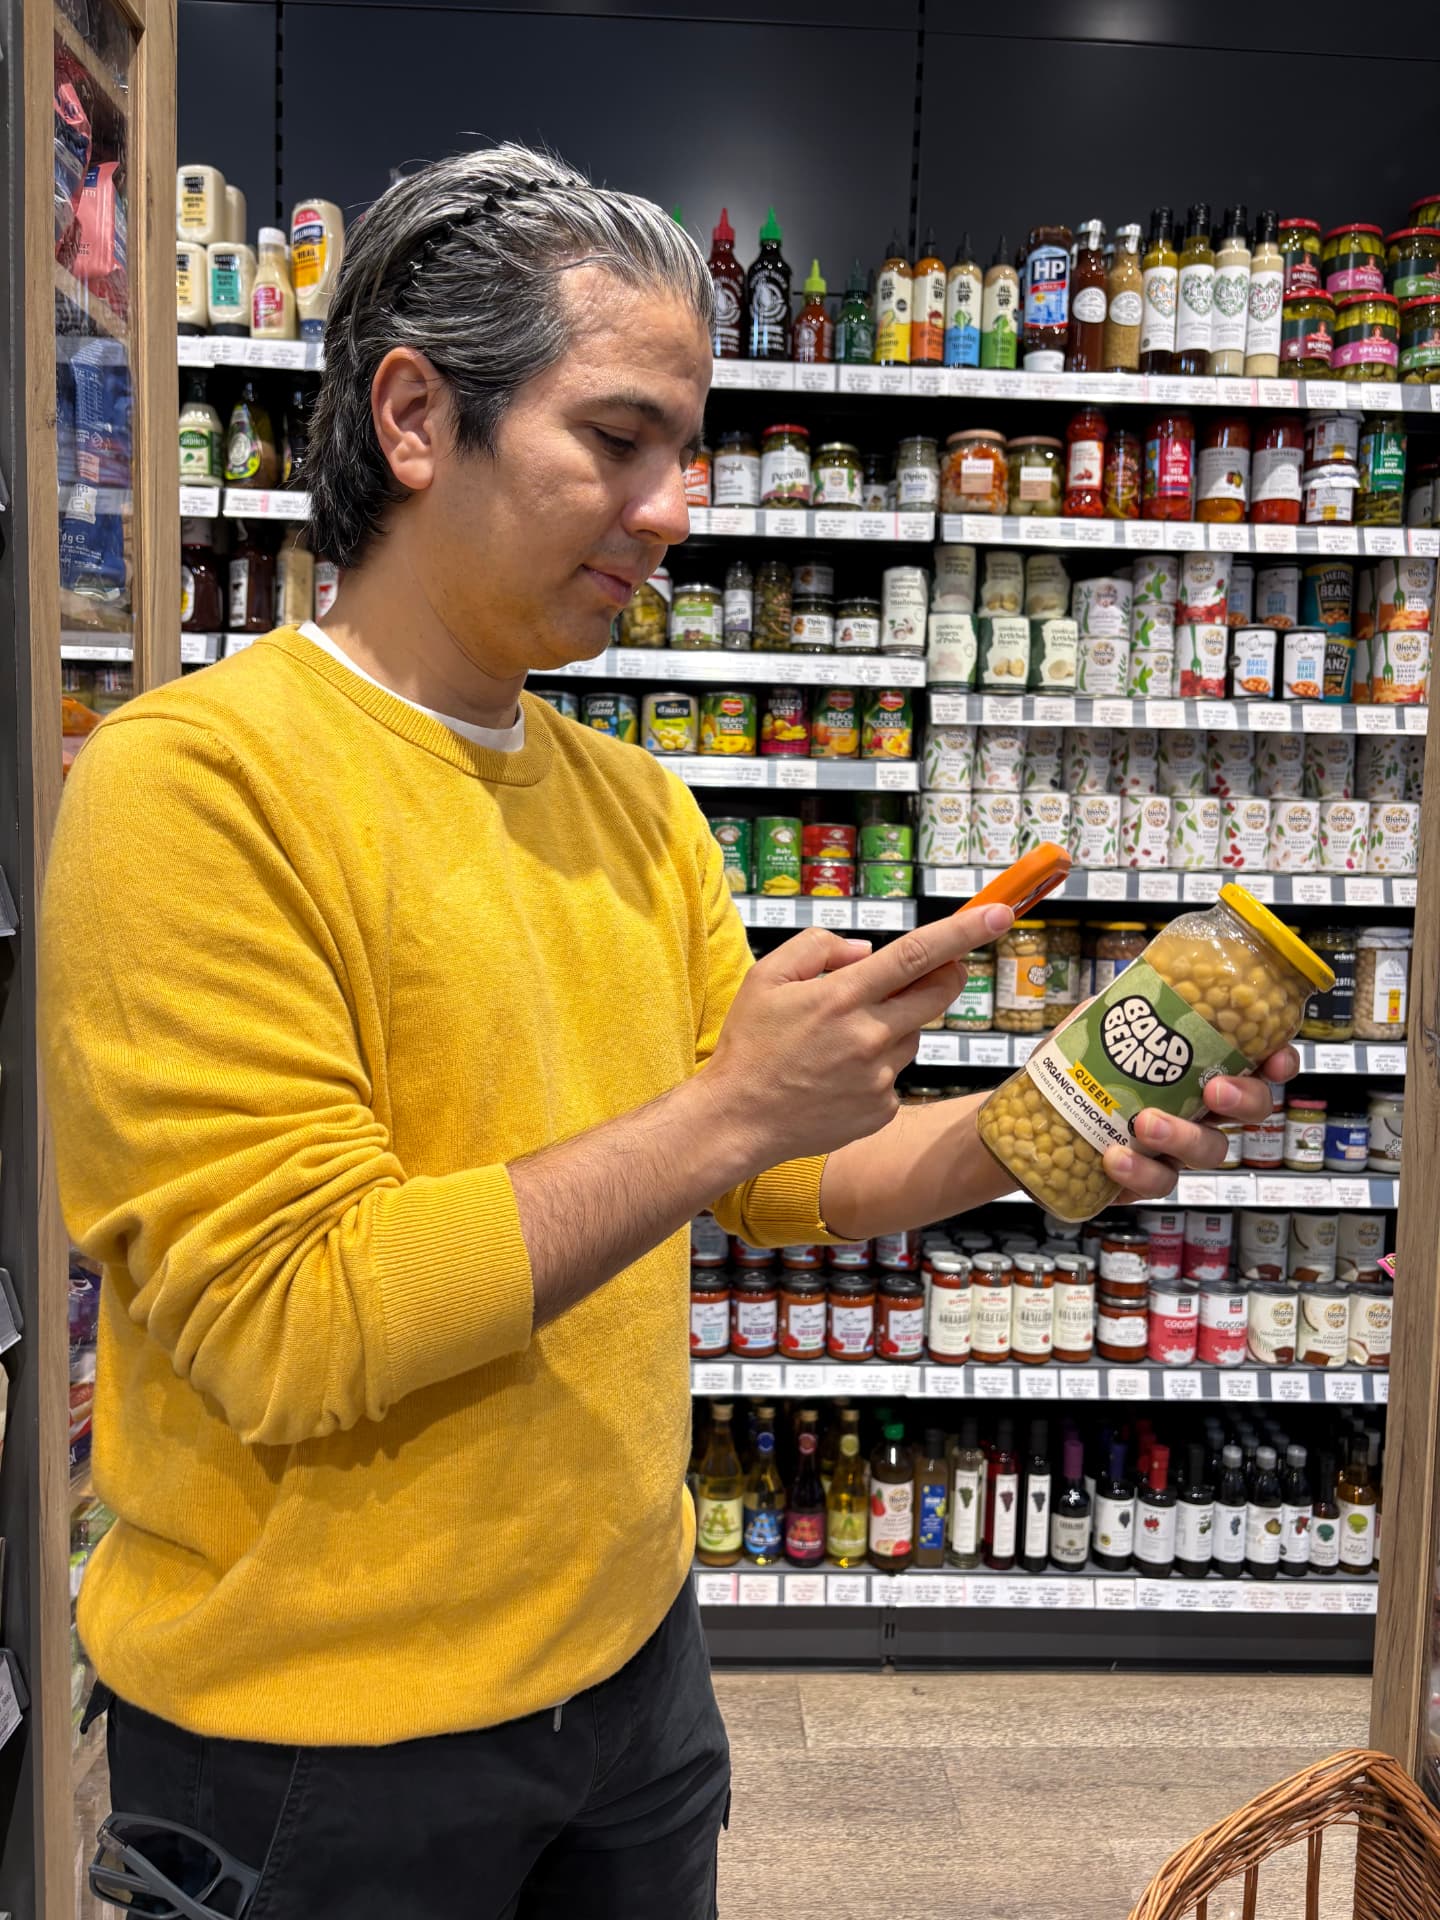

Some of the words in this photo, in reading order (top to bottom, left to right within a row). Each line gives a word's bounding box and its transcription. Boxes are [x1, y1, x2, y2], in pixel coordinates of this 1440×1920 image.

[1033, 260, 1066, 281] HP
[1328, 643, 1342, 653] INZ
[1325, 657, 1346, 669] ANZ
[767, 699, 801, 710] MANGO
[827, 712, 853, 721] PEACH
[879, 712, 902, 721] FRUIT
[1384, 816, 1408, 824] Biona
[1123, 997, 1190, 1067] BOLD
[1104, 1005, 1154, 1079] BEAN
[1074, 1068, 1113, 1108] QUEEN
[1042, 1056, 1076, 1096] ORGANIC
[1073, 1094, 1129, 1147] CHICKPEAS
[1063, 1100, 1091, 1131] DELICIOUS
[1216, 1320, 1245, 1330] COCON
